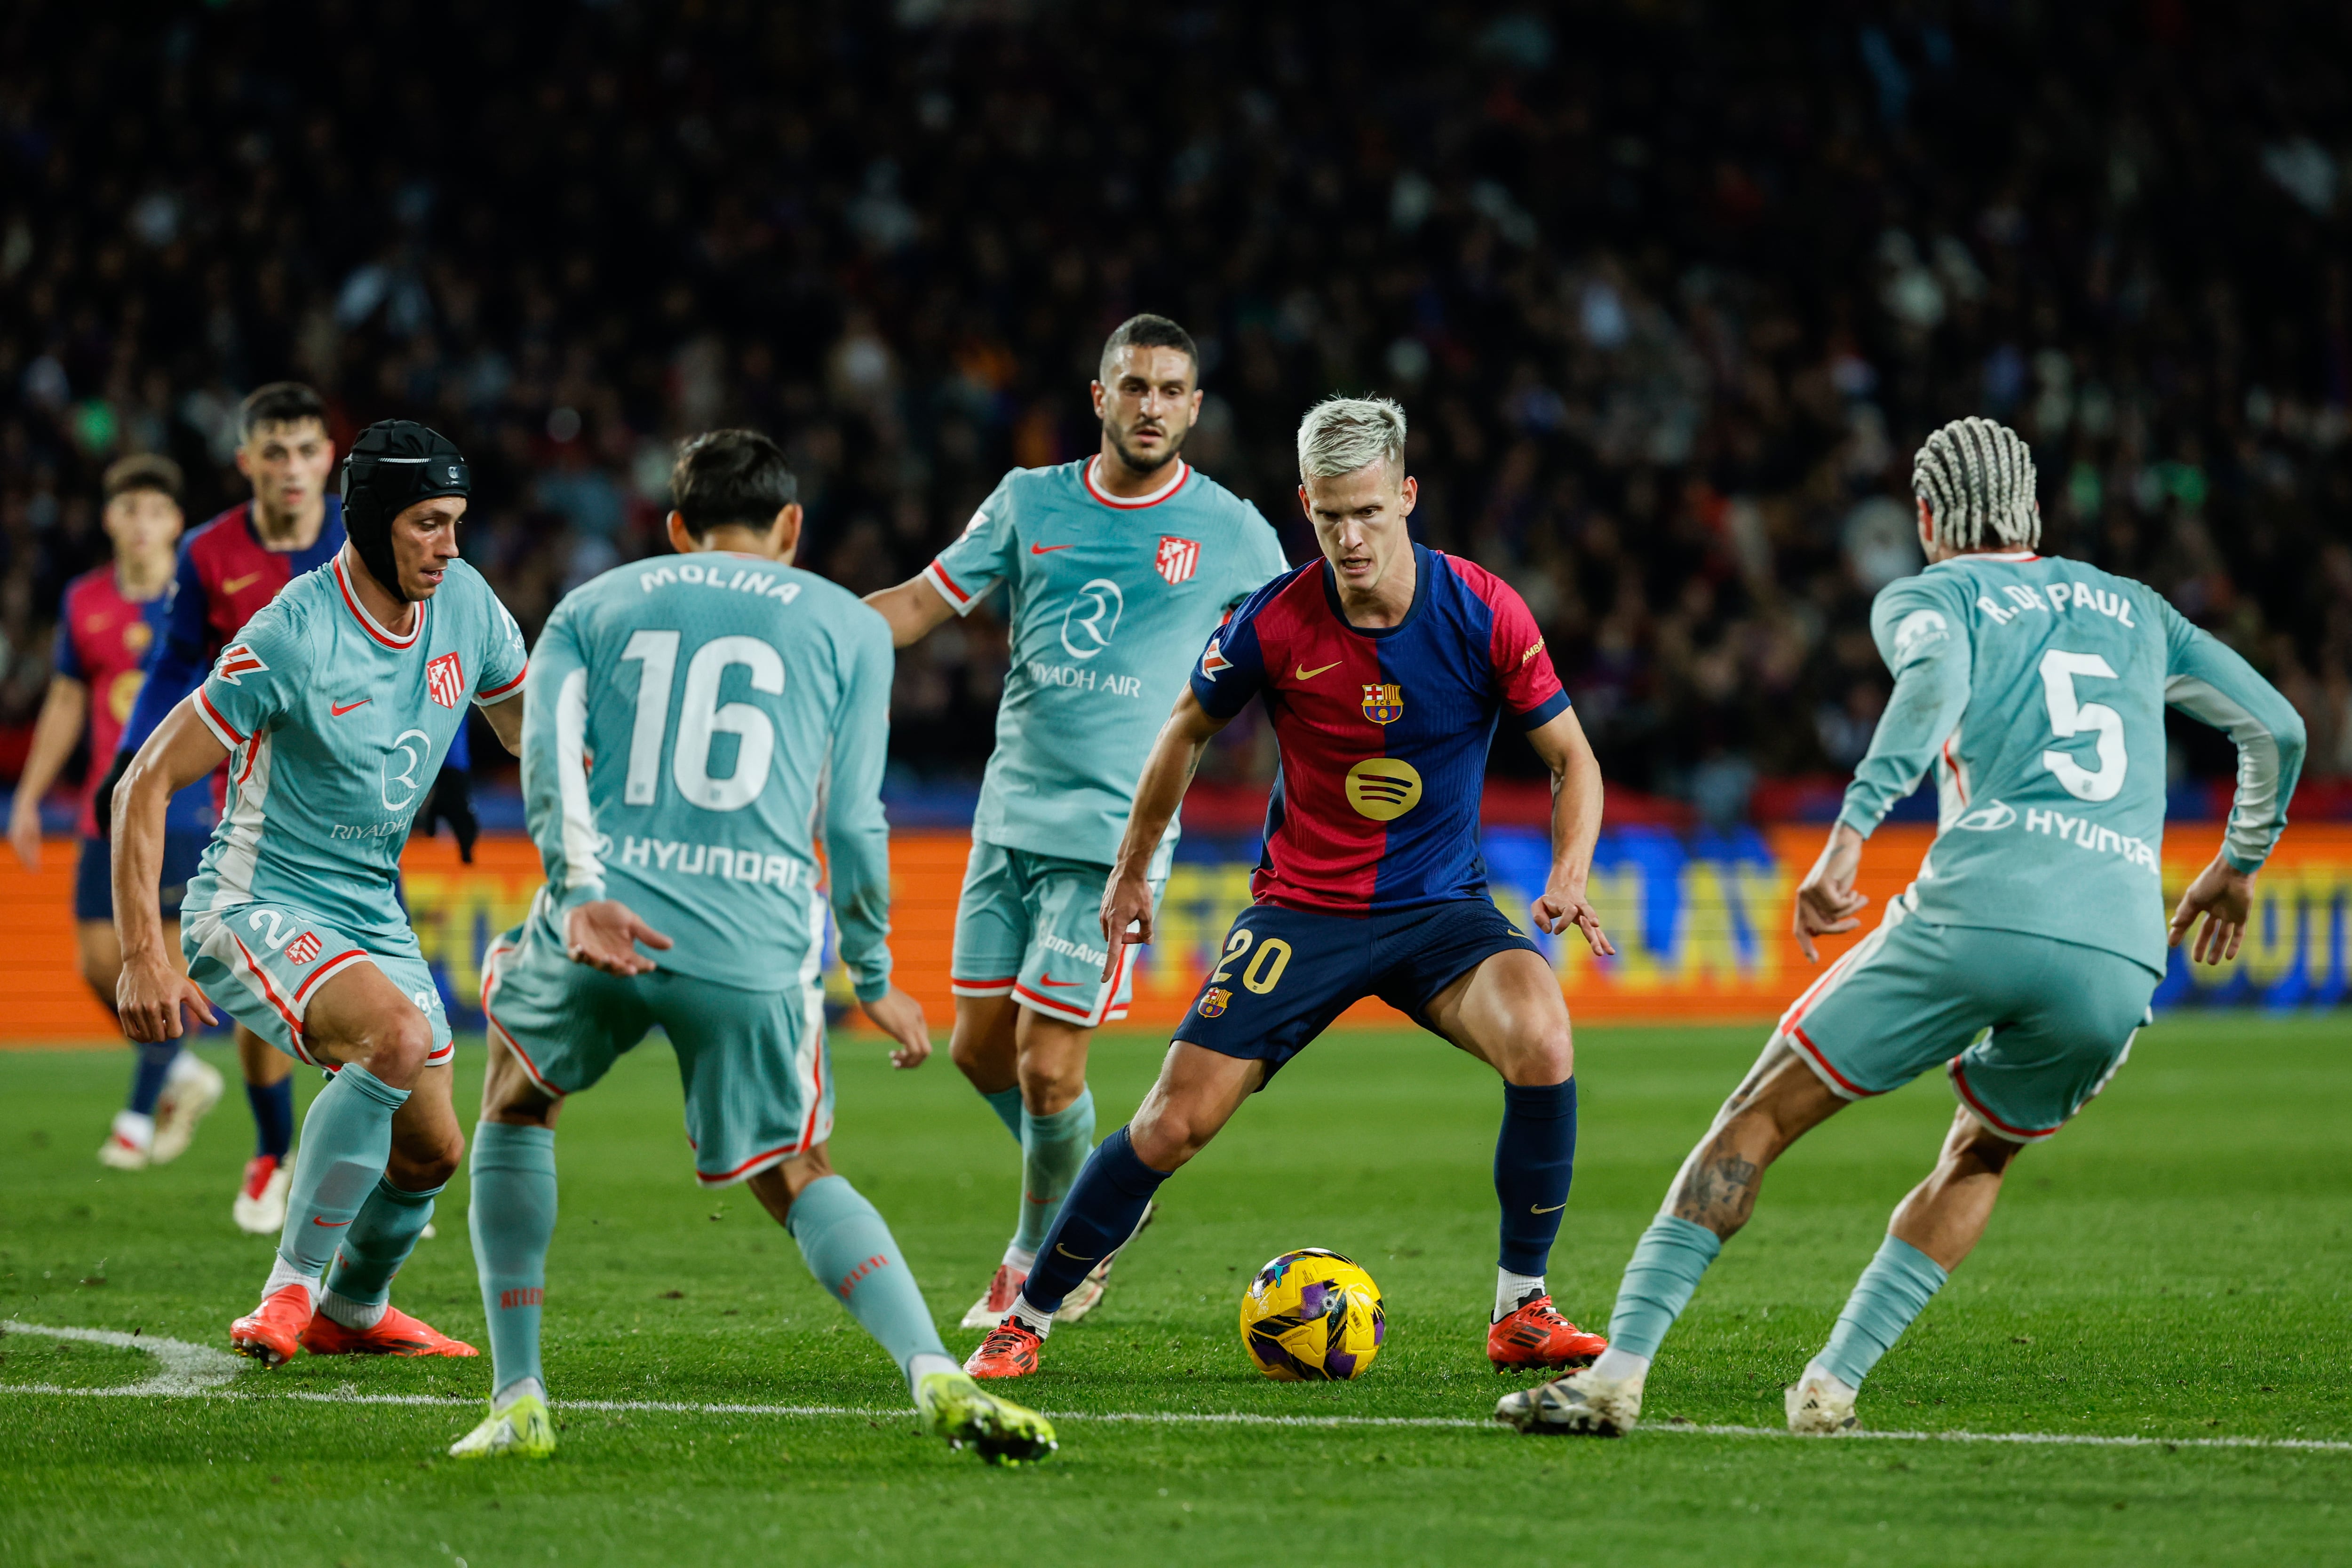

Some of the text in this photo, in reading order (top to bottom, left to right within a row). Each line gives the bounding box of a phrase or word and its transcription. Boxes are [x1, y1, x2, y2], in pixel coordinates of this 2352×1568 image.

[639, 564, 801, 605] MOLINA
[2002, 585, 2049, 611] DE
[2046, 581, 2136, 629] PAUL
[1100, 673, 1142, 698] AIR
[621, 630, 786, 812] 16
[2039, 648, 2128, 801] 5
[330, 815, 410, 840] RIYADH
[2025, 807, 2159, 875] HYUNDA
[621, 834, 800, 888] HYUNDAI
[1211, 928, 1292, 995] 20
[501, 1287, 544, 1310] ATLET
[839, 1254, 889, 1300] ATLETI
